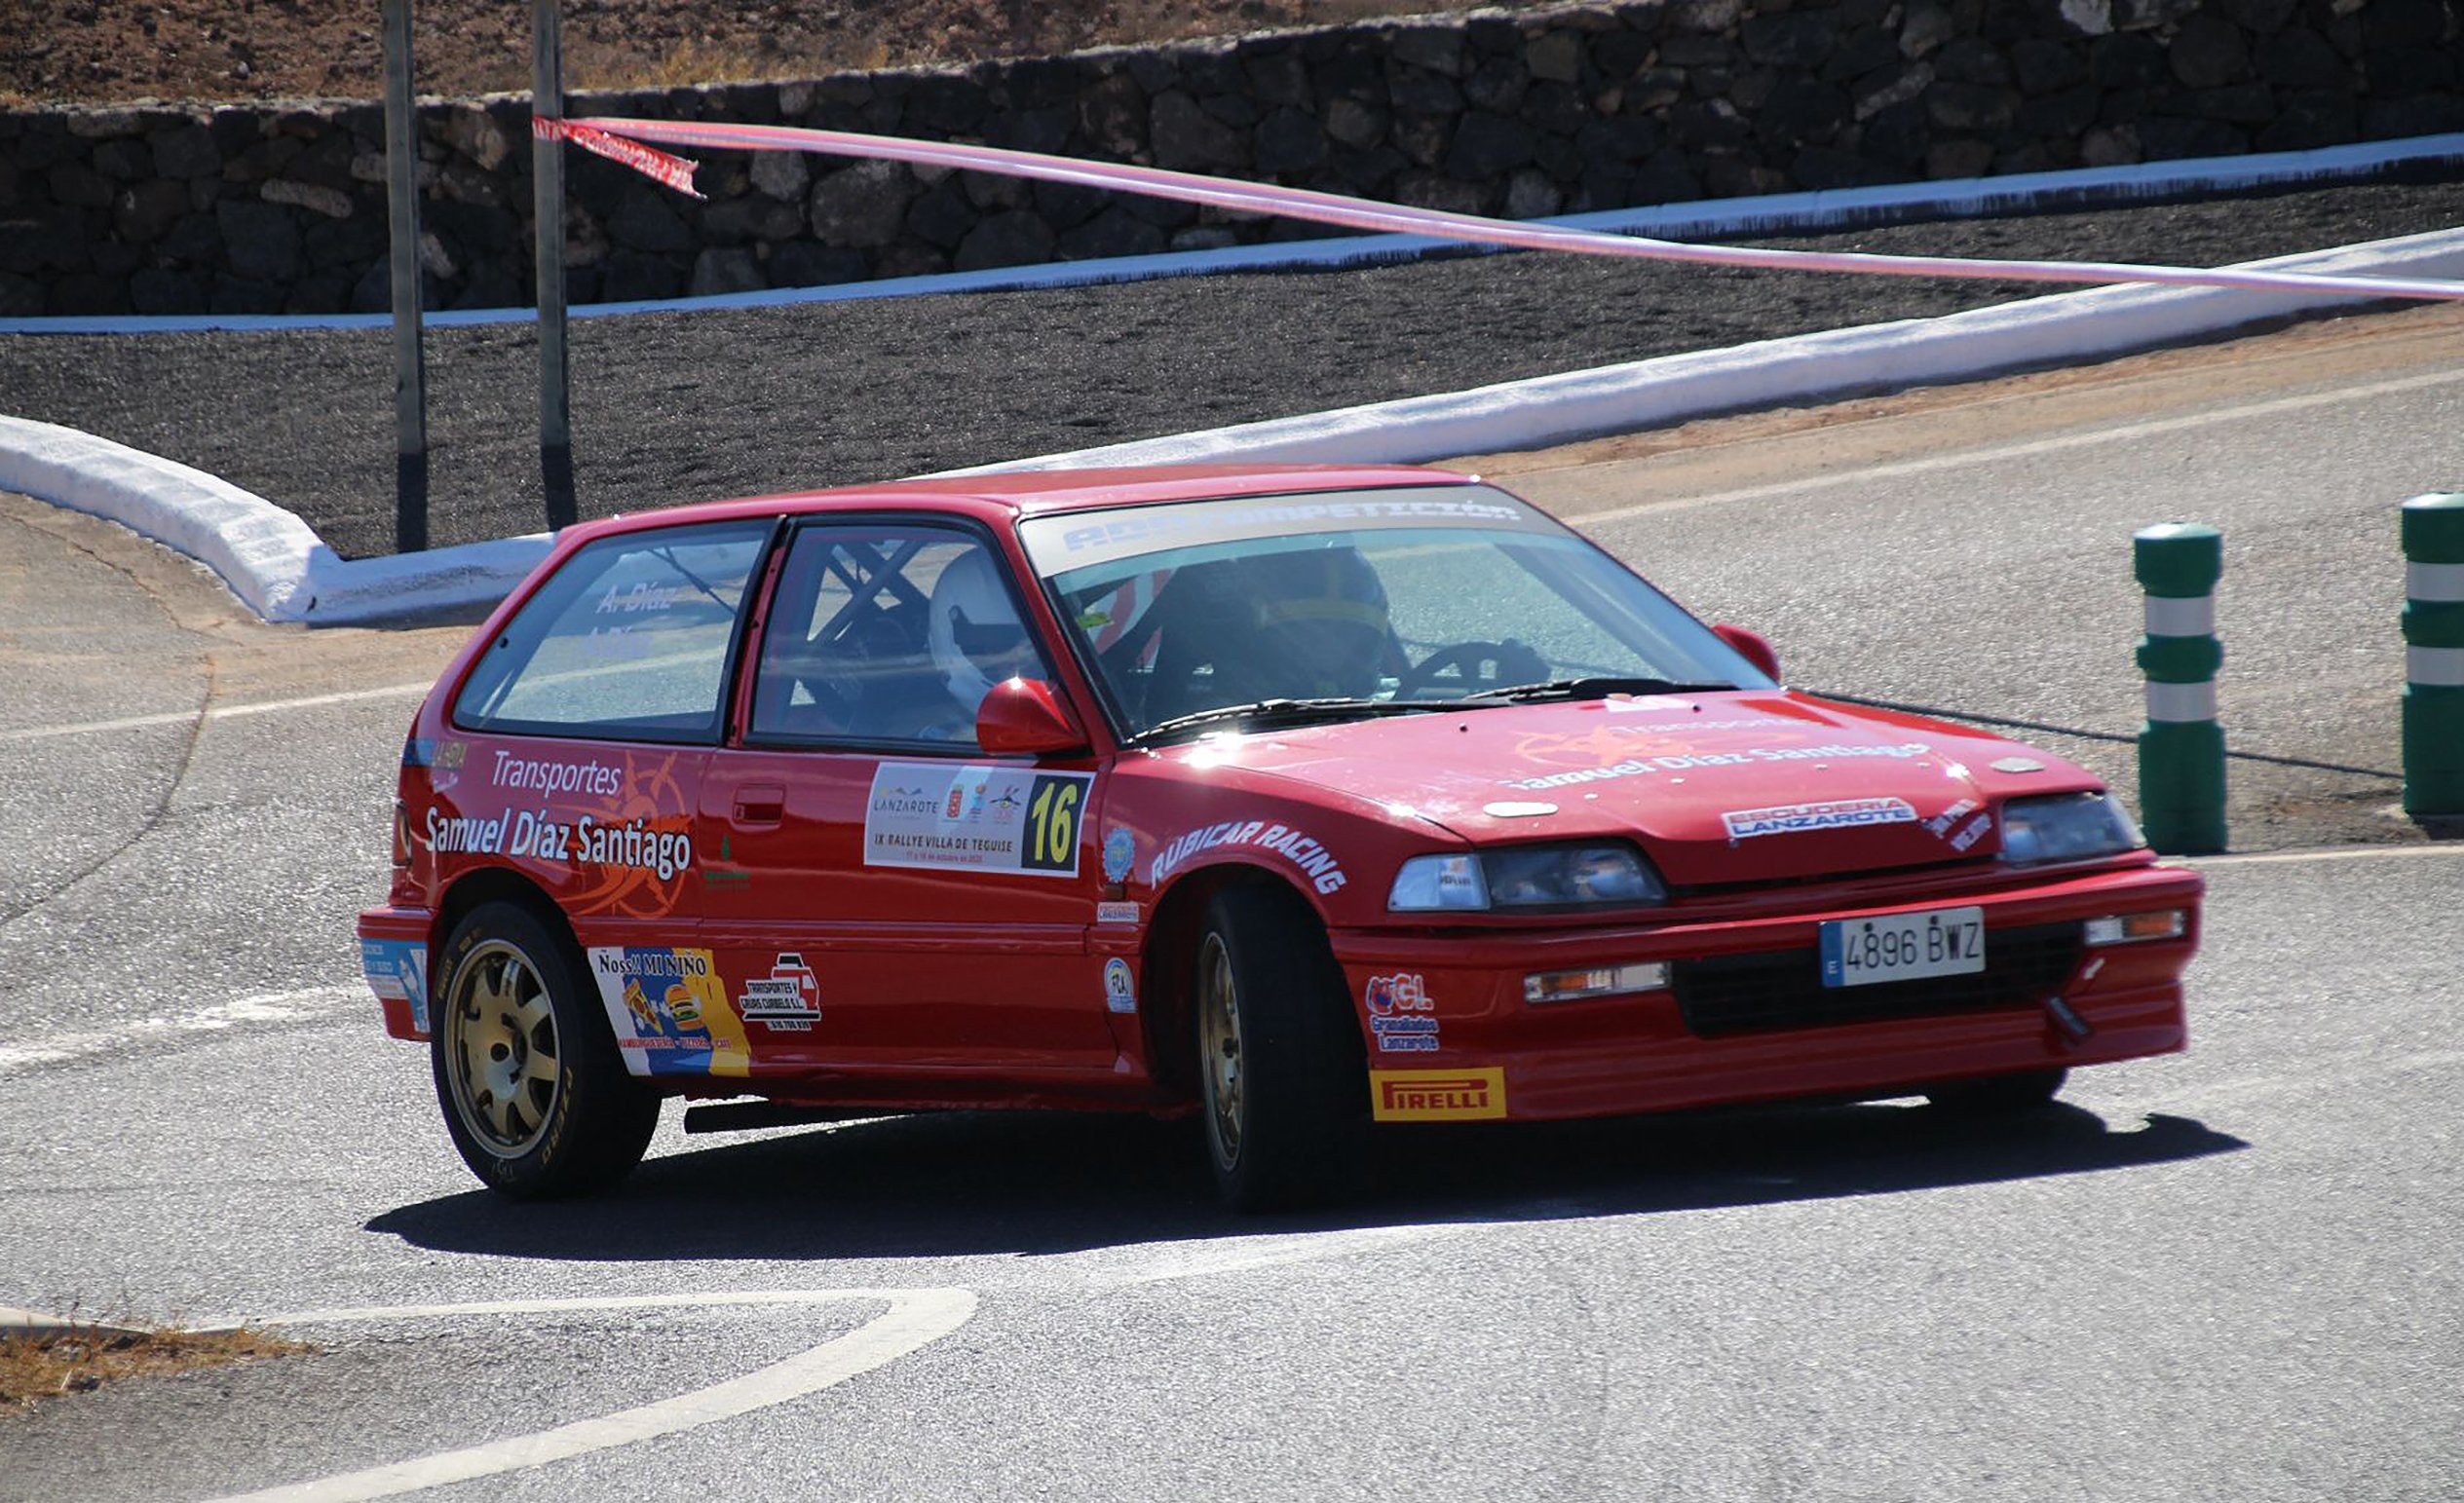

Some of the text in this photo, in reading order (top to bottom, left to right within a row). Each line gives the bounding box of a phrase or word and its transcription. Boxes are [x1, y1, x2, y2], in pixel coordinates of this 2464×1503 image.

[492, 750, 621, 799] Transportes
[874, 799, 939, 814] LANZAROTE
[1728, 799, 1907, 823] ESCUDERIA
[1031, 782, 1079, 864] 16
[1731, 808, 1912, 835] LANZAROTE
[425, 806, 691, 881] Samuel Díaz Santiago
[888, 834, 924, 847] RALLYE
[926, 835, 955, 849] VILLA
[955, 838, 967, 849] DE
[971, 839, 1013, 852] TEGUISE
[1151, 821, 1347, 895] RUBICAR RACING
[1846, 921, 1980, 971] 4896 BWZ
[644, 953, 663, 975] MI
[665, 951, 706, 976] NIÑO
[747, 982, 792, 994] TRANSPORTES
[1381, 1078, 1490, 1110] PIRELLI
